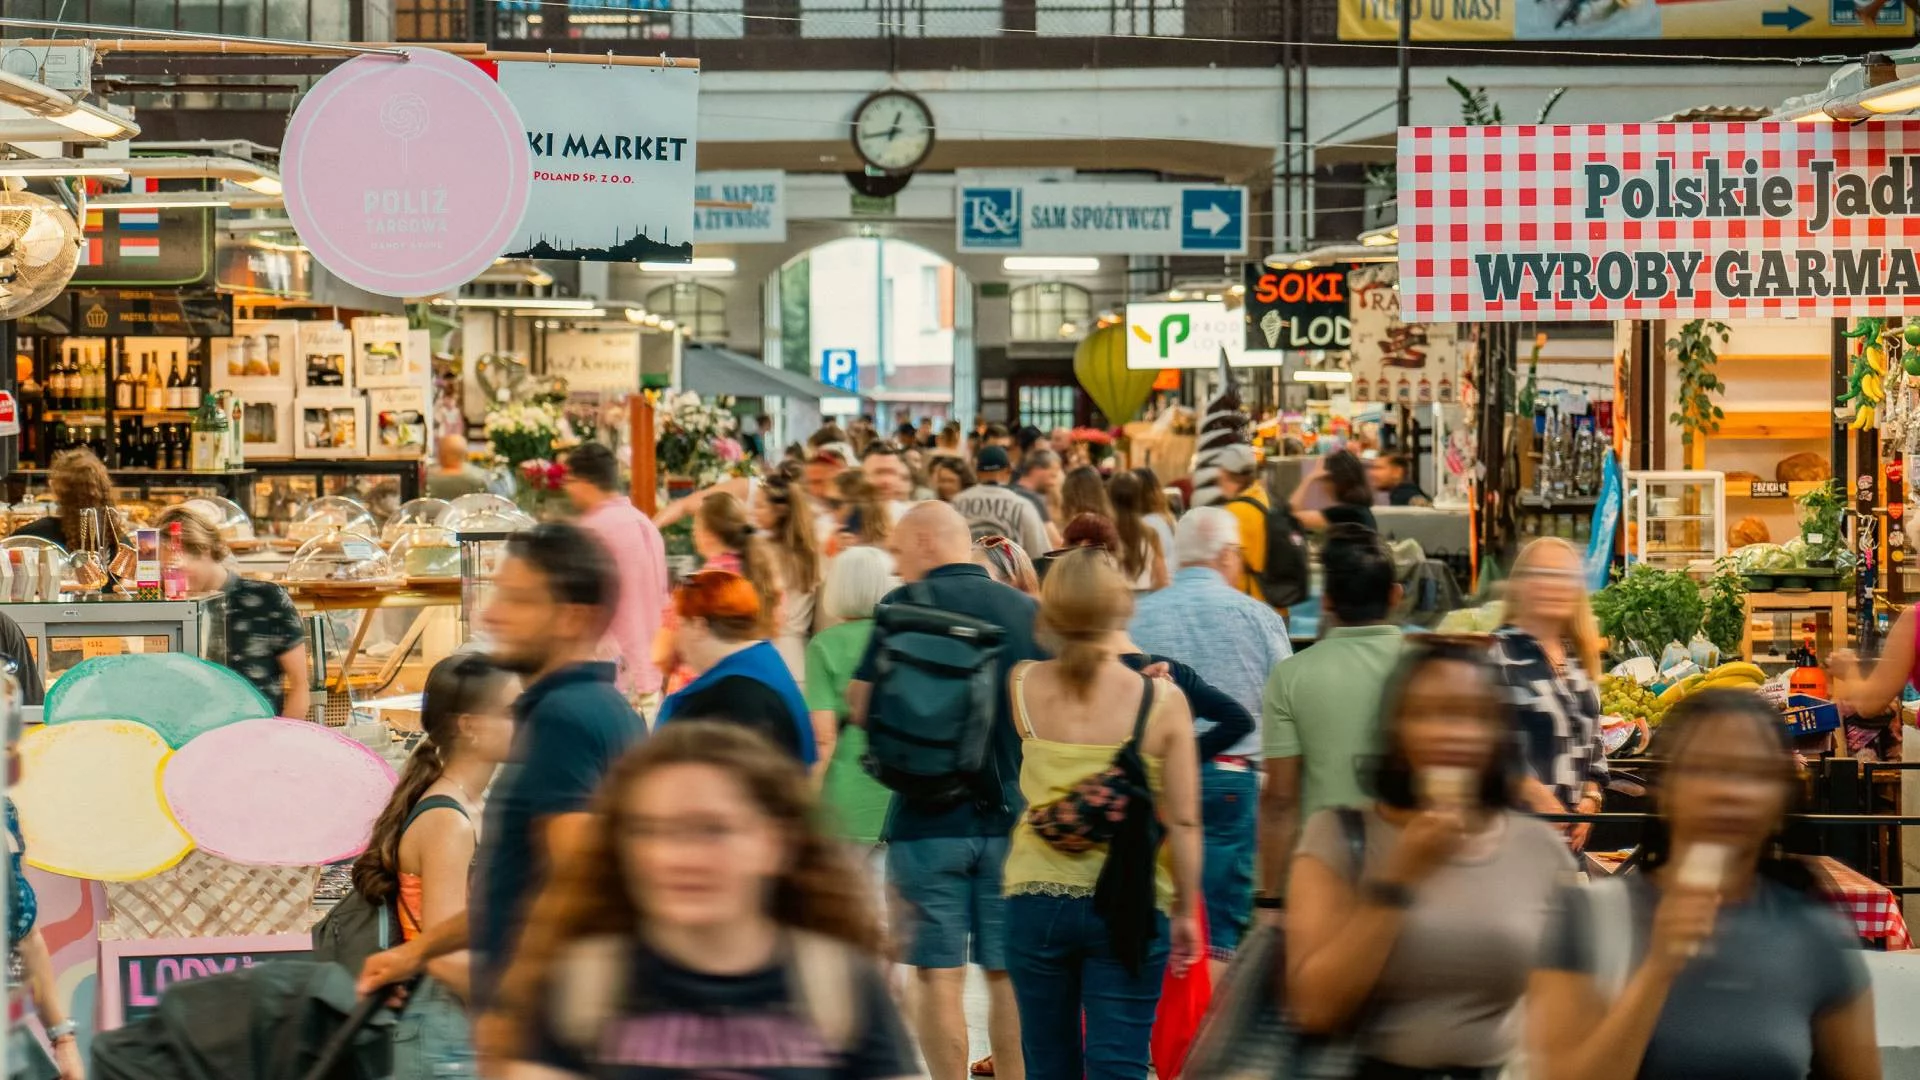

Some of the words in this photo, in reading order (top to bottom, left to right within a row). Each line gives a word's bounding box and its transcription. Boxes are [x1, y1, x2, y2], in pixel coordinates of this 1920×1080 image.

[1430, 0, 1444, 20] U
[527, 132, 553, 157] KI
[562, 133, 687, 161] MARKET
[533, 171, 580, 182] POLAND
[1584, 158, 1793, 218] Polskie
[364, 183, 448, 214] POLIŻ
[722, 184, 776, 203] NAPOJE
[365, 219, 449, 233] TARGOWA
[1031, 205, 1067, 229] SAM
[1071, 201, 1172, 230] SPOŻYWCZY
[1255, 273, 1344, 305] SOKI
[1475, 251, 1703, 300] WYROBY
[1714, 249, 1920, 298] GARMA
[1290, 316, 1352, 346] LOD
[828, 351, 852, 383] P
